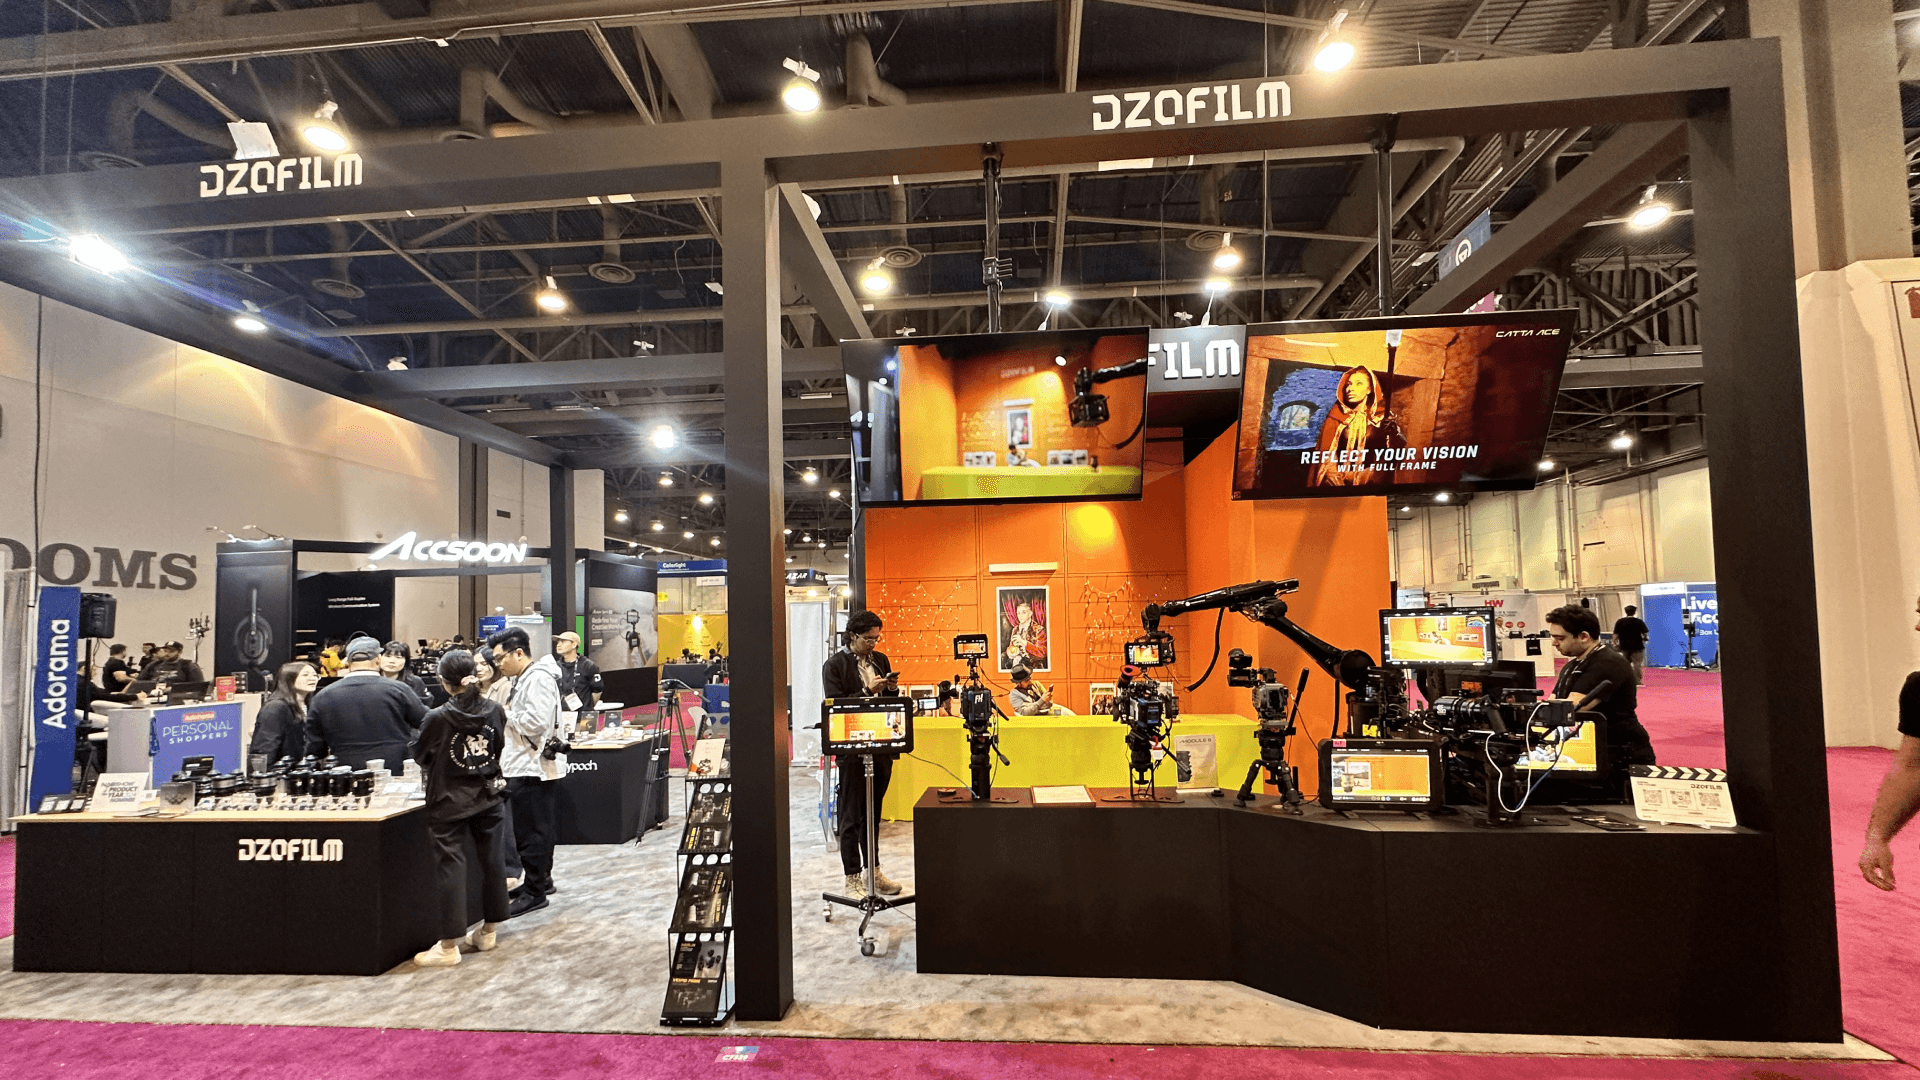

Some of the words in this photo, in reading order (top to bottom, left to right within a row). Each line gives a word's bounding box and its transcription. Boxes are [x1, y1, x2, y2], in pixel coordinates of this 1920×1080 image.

[1092, 81, 1292, 131] DZOFILM
[200, 153, 363, 198] DZOFILM
[1495, 329, 1535, 338] CATTA
[1536, 328, 1561, 336] ACE
[1300, 449, 1369, 464] REFLECT
[1374, 447, 1417, 462] YOUR
[1422, 444, 1479, 460] VISION
[1337, 463, 1365, 473] WITH
[1369, 462, 1396, 472] FULL
[1399, 461, 1437, 470] FRAME
[1681, 596, 1718, 610] Live
[42, 619, 70, 729] Adorama
[162, 720, 234, 737] PERSONAL
[169, 731, 228, 744] SHOPPERS
[238, 839, 344, 862] DZOFILM
